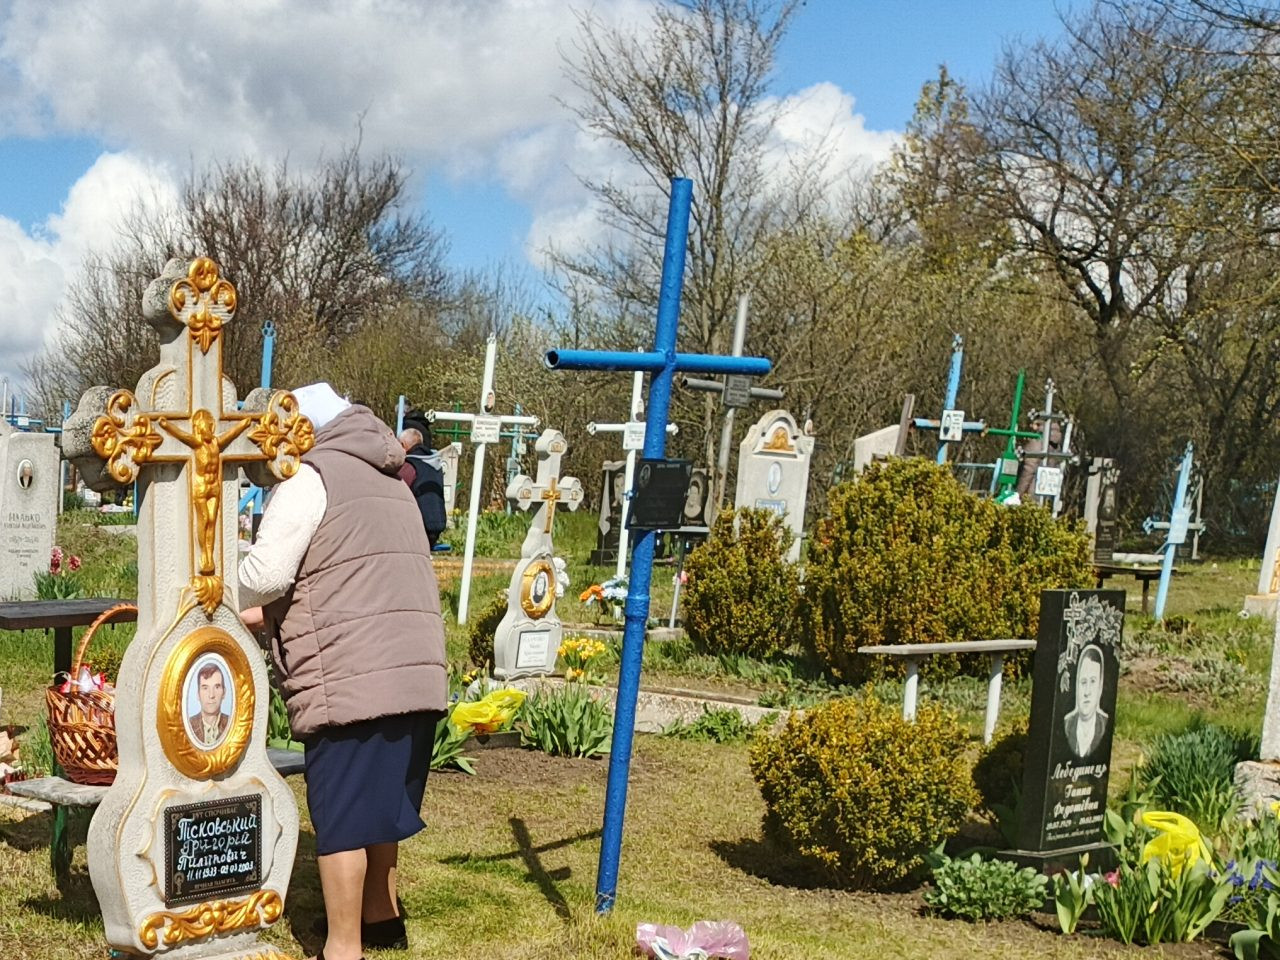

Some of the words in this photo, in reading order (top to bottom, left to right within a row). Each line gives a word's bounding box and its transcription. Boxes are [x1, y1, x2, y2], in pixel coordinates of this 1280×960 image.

[1051, 760, 1107, 782] Лебединець
[1064, 784, 1092, 798] Ганна
[177, 814, 258, 841] Пісковський
